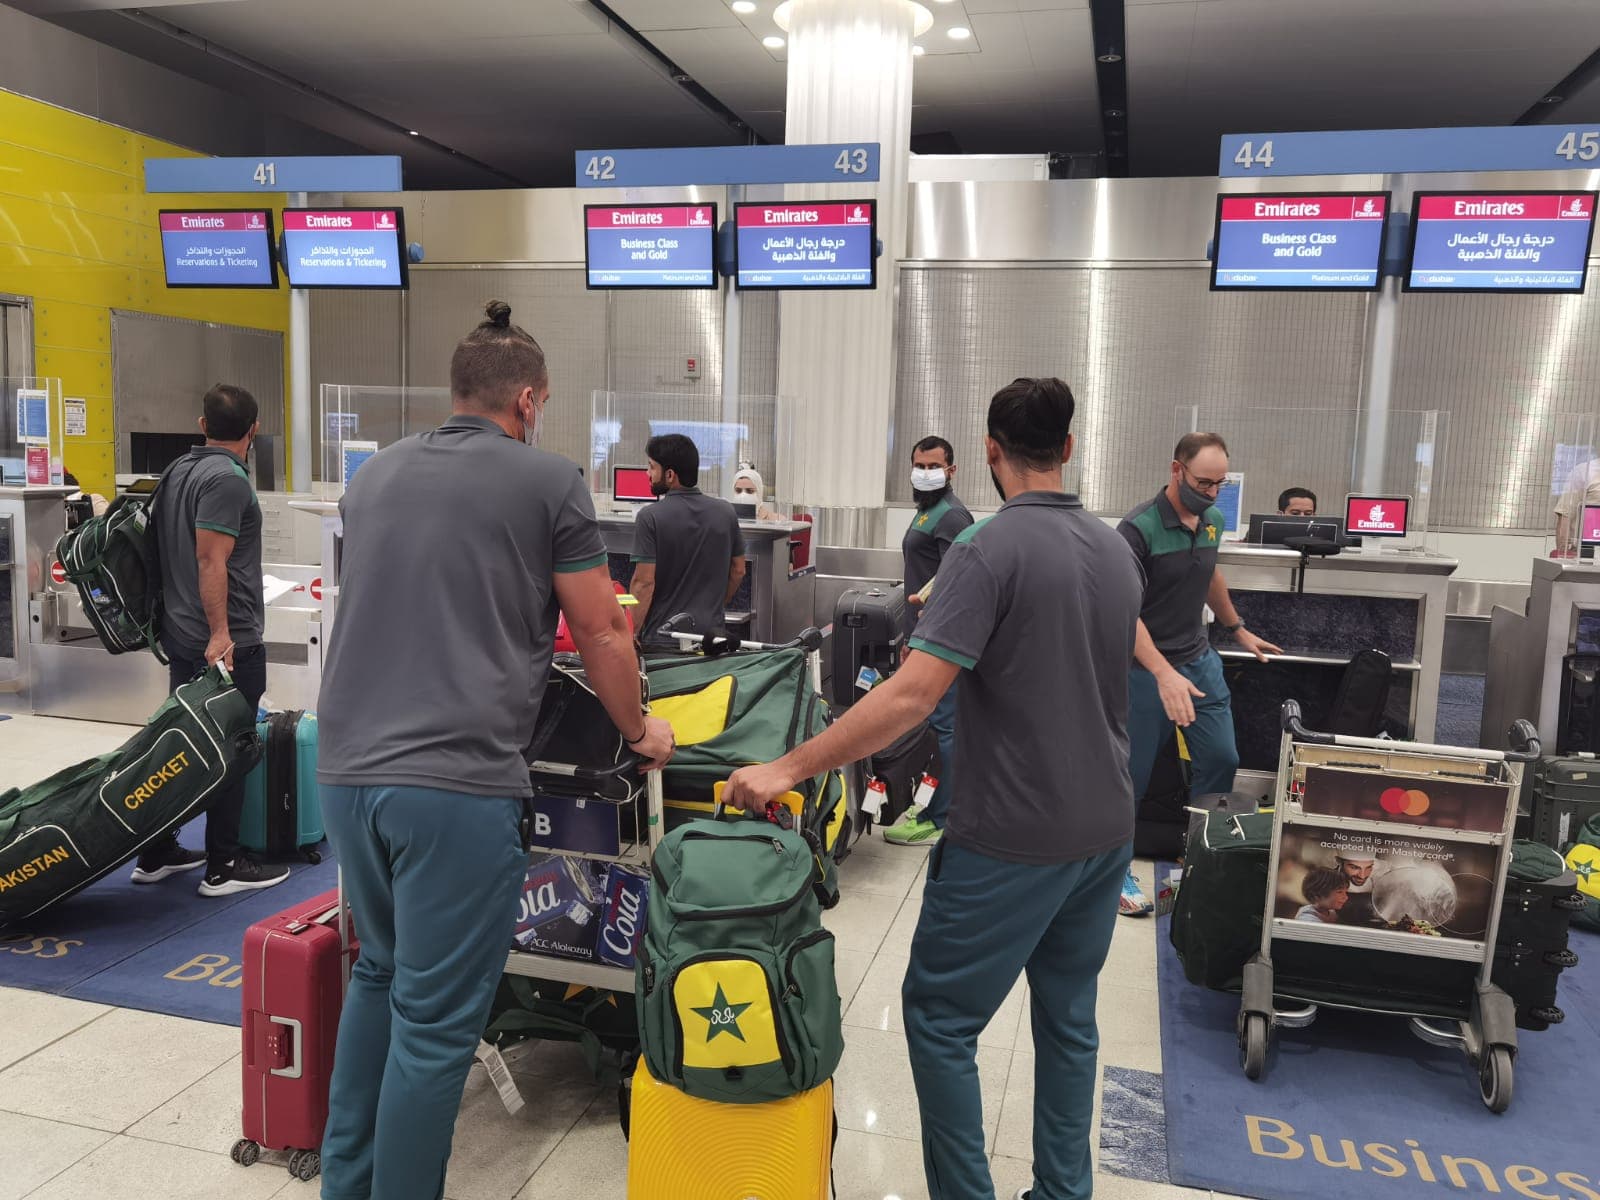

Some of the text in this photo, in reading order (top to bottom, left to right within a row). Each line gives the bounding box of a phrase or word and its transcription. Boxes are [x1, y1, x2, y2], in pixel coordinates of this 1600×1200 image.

[1556, 131, 1600, 161] 45
[834, 148, 868, 175] 43
[1234, 140, 1275, 169] 44
[253, 162, 277, 185] 41
[585, 155, 616, 181] 42
[1254, 201, 1321, 217] Emirates
[1454, 200, 1525, 216] Emirates
[181, 215, 225, 228] Emirates
[305, 214, 353, 228] Emirates
[612, 211, 664, 225] Emirates
[763, 208, 819, 224] Emirates
[620, 238, 679, 249] Business Class
[796, 237, 818, 250] رجال
[820, 237, 846, 249] درجة
[1261, 232, 1337, 245] Business Class
[1447, 231, 1555, 248] درجة رجال الأعمال
[631, 250, 668, 260] and Gold
[1273, 246, 1323, 257] and Gold
[1457, 248, 1501, 262] الذهبية
[176, 257, 258, 268] Reservations & Ticketing
[300, 257, 387, 269] Reservations & Ticketing
[1311, 274, 1370, 282] Platinum and Gold
[1357, 519, 1395, 529] Emirates
[124, 751, 190, 811] CRICKET
[534, 812, 551, 836] B
[1320, 840, 1364, 852] accepted
[1366, 844, 1389, 854] than
[1333, 832, 1445, 852] No card is more widely
